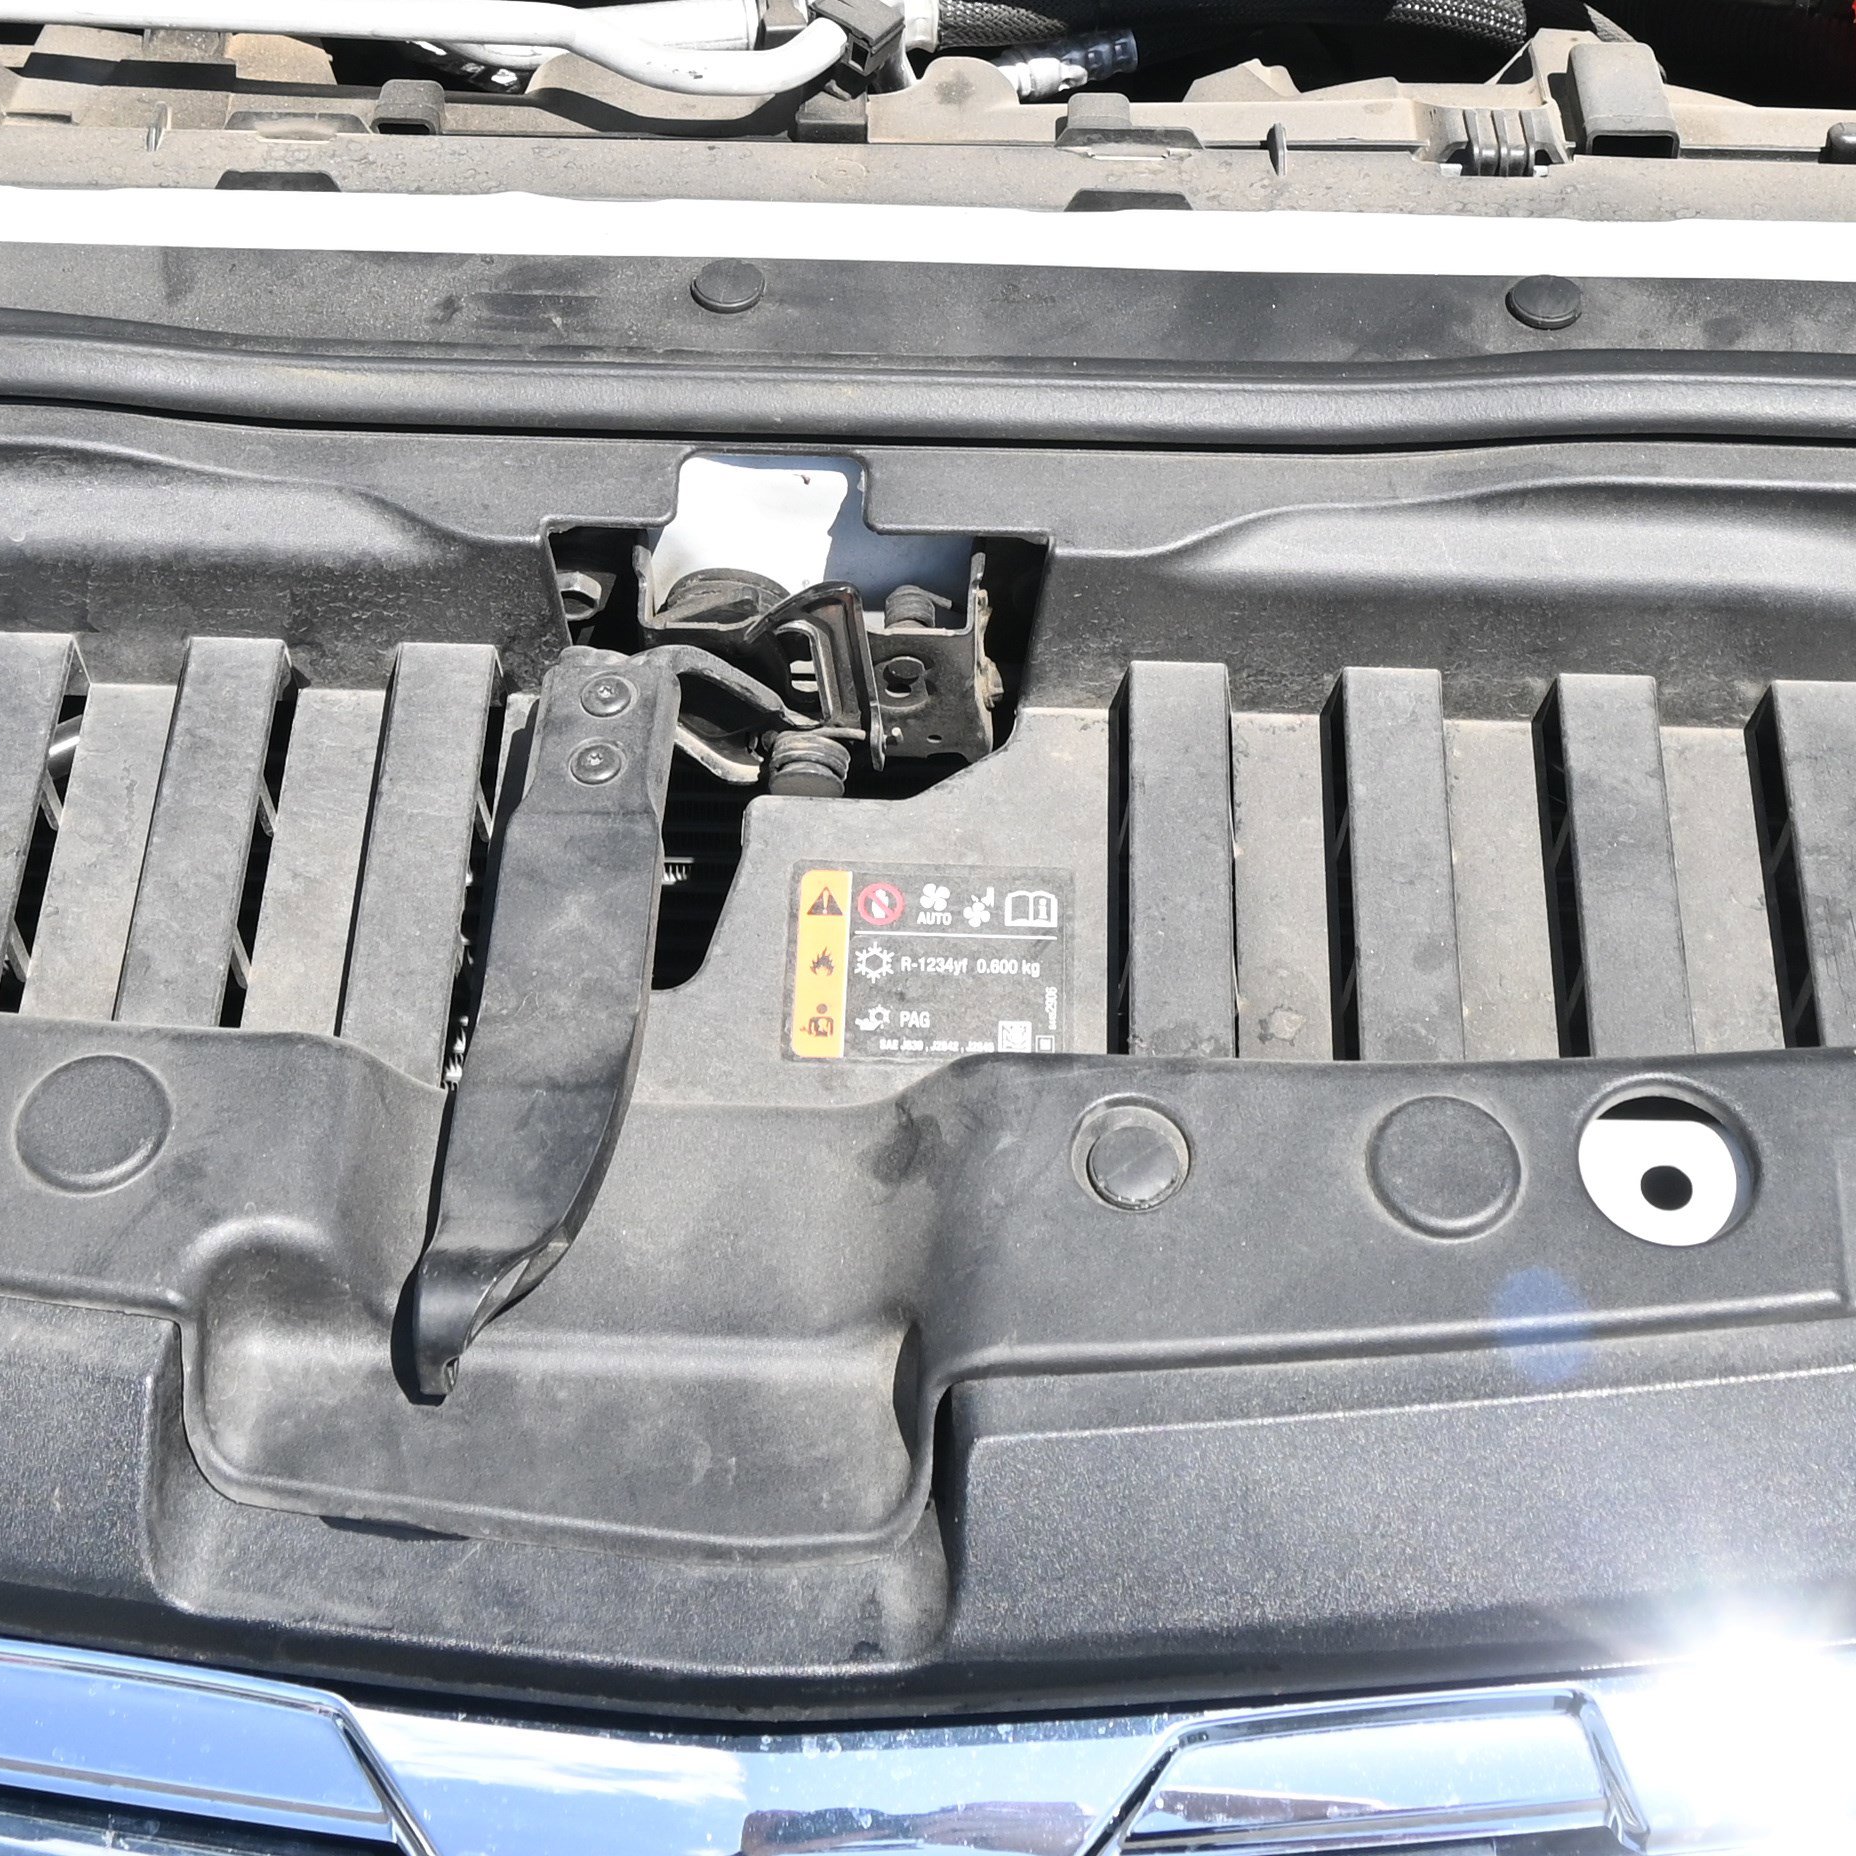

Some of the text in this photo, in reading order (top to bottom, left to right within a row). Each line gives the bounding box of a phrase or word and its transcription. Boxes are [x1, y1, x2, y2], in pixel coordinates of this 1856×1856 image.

[917, 911, 952, 925] AUTO
[900, 956, 1040, 977] R-1234yf 0.600 kg
[900, 1011, 930, 1028] PAG
